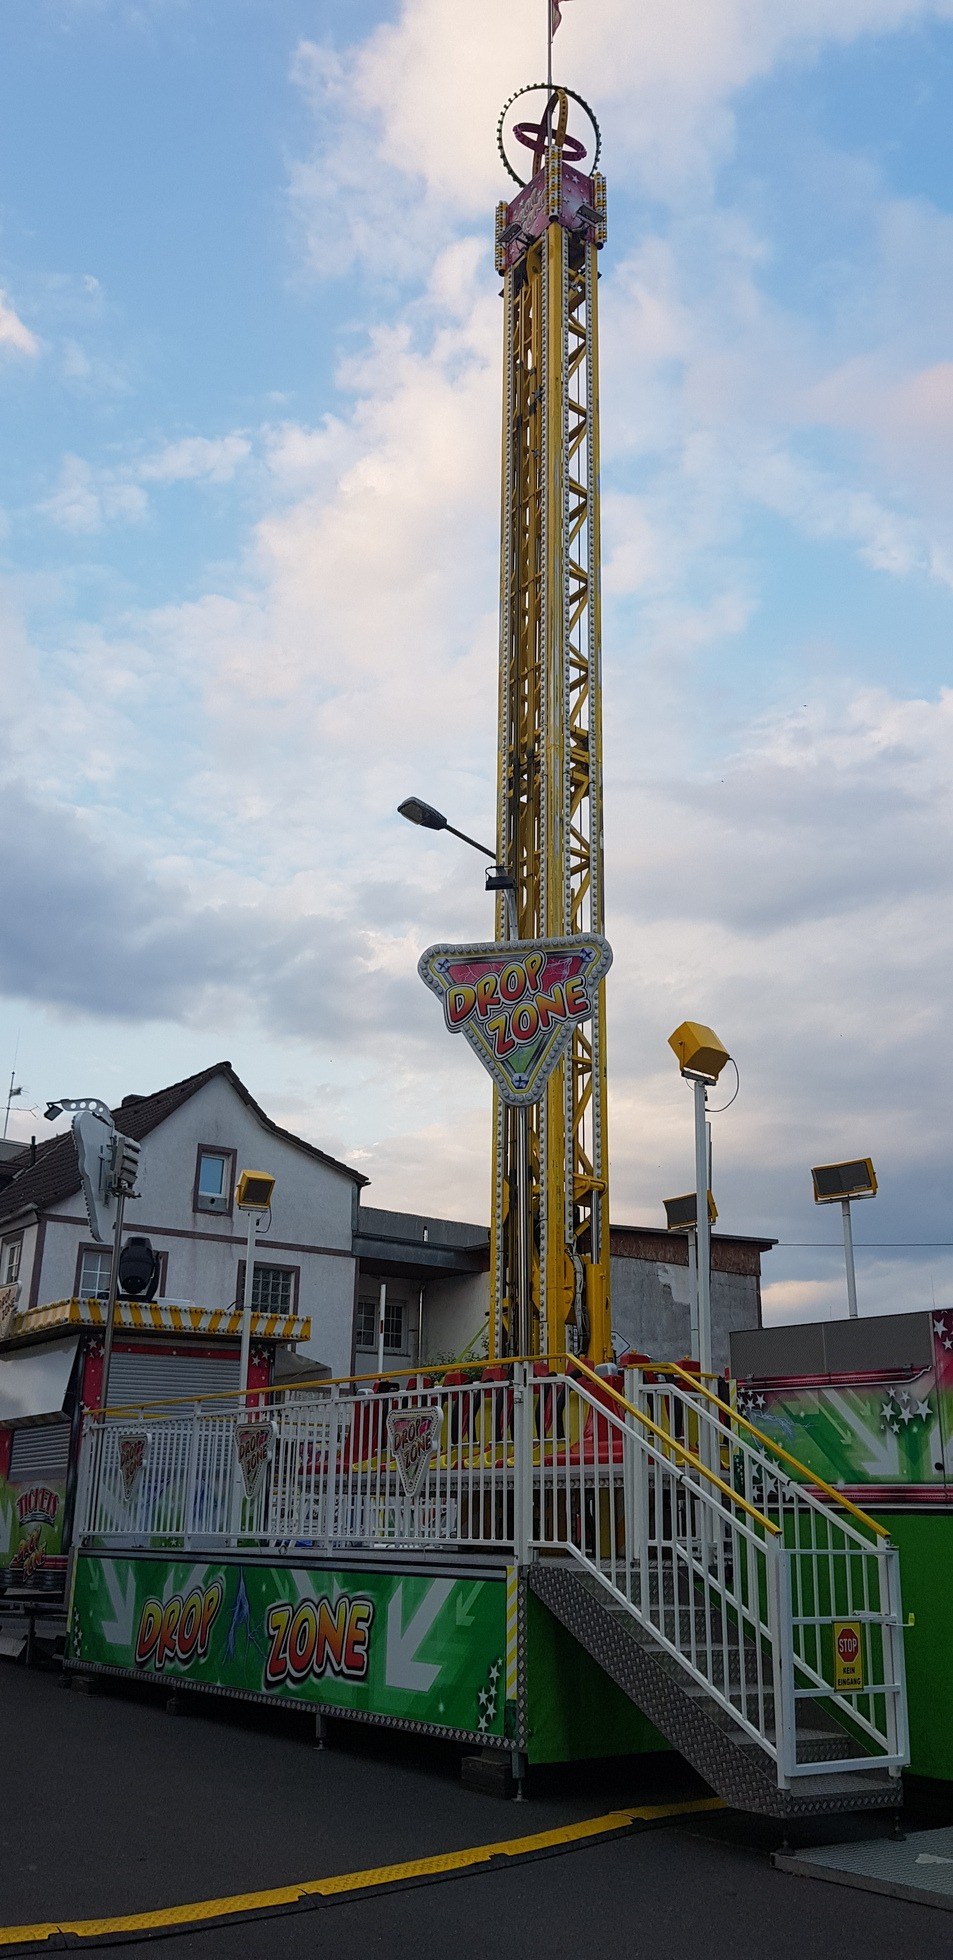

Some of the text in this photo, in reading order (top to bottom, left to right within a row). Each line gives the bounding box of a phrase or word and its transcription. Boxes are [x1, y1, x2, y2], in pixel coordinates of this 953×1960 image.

[447, 951, 546, 1026] DROP
[486, 975, 590, 1058] ZONE
[239, 1431, 264, 1460] DROP
[394, 1417, 422, 1452] DROP
[404, 1431, 432, 1469] ZONE
[136, 1581, 372, 1681] DROP ZONE
[838, 1638, 858, 1653] STOP
[838, 1678, 861, 1686] EINGANG
